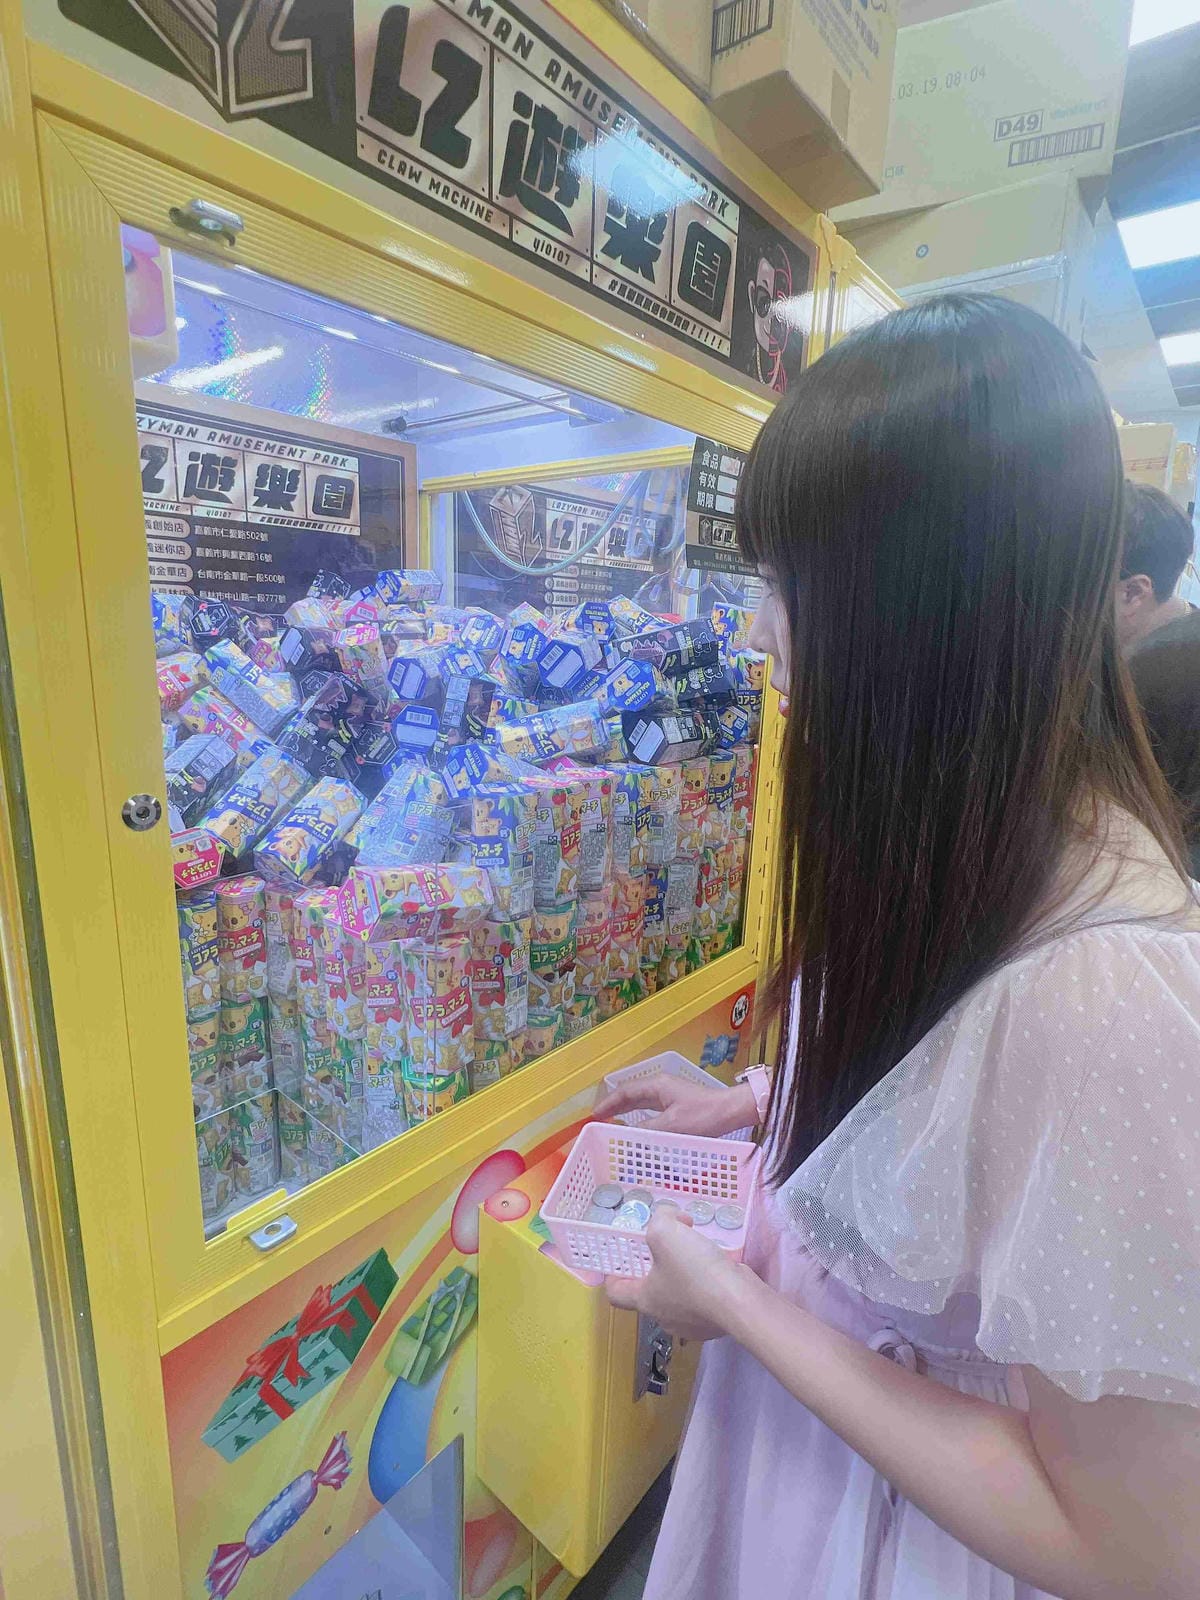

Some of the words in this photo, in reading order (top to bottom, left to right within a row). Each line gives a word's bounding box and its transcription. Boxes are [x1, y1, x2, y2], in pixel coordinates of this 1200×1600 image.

[998, 114, 1040, 138] D49
[377, 149, 422, 181] CLAW
[429, 177, 494, 223] MACHINE
[207, 431, 307, 460] AMUSEMENT
[312, 450, 349, 468] PARK
[702, 449, 719, 470] 食品
[699, 471, 717, 490] 有效
[697, 491, 715, 509] 期限
[229, 793, 272, 818] コアラのマーチ
[288, 811, 333, 836] コアラのマーチ
[180, 859, 217, 878] コアラのマーチ
[191, 870, 214, 882] LOTTE
[193, 945, 219, 965] コアラ
[532, 940, 573, 963] コアラのマーチ
[415, 991, 466, 1018] コアラのマーチ
